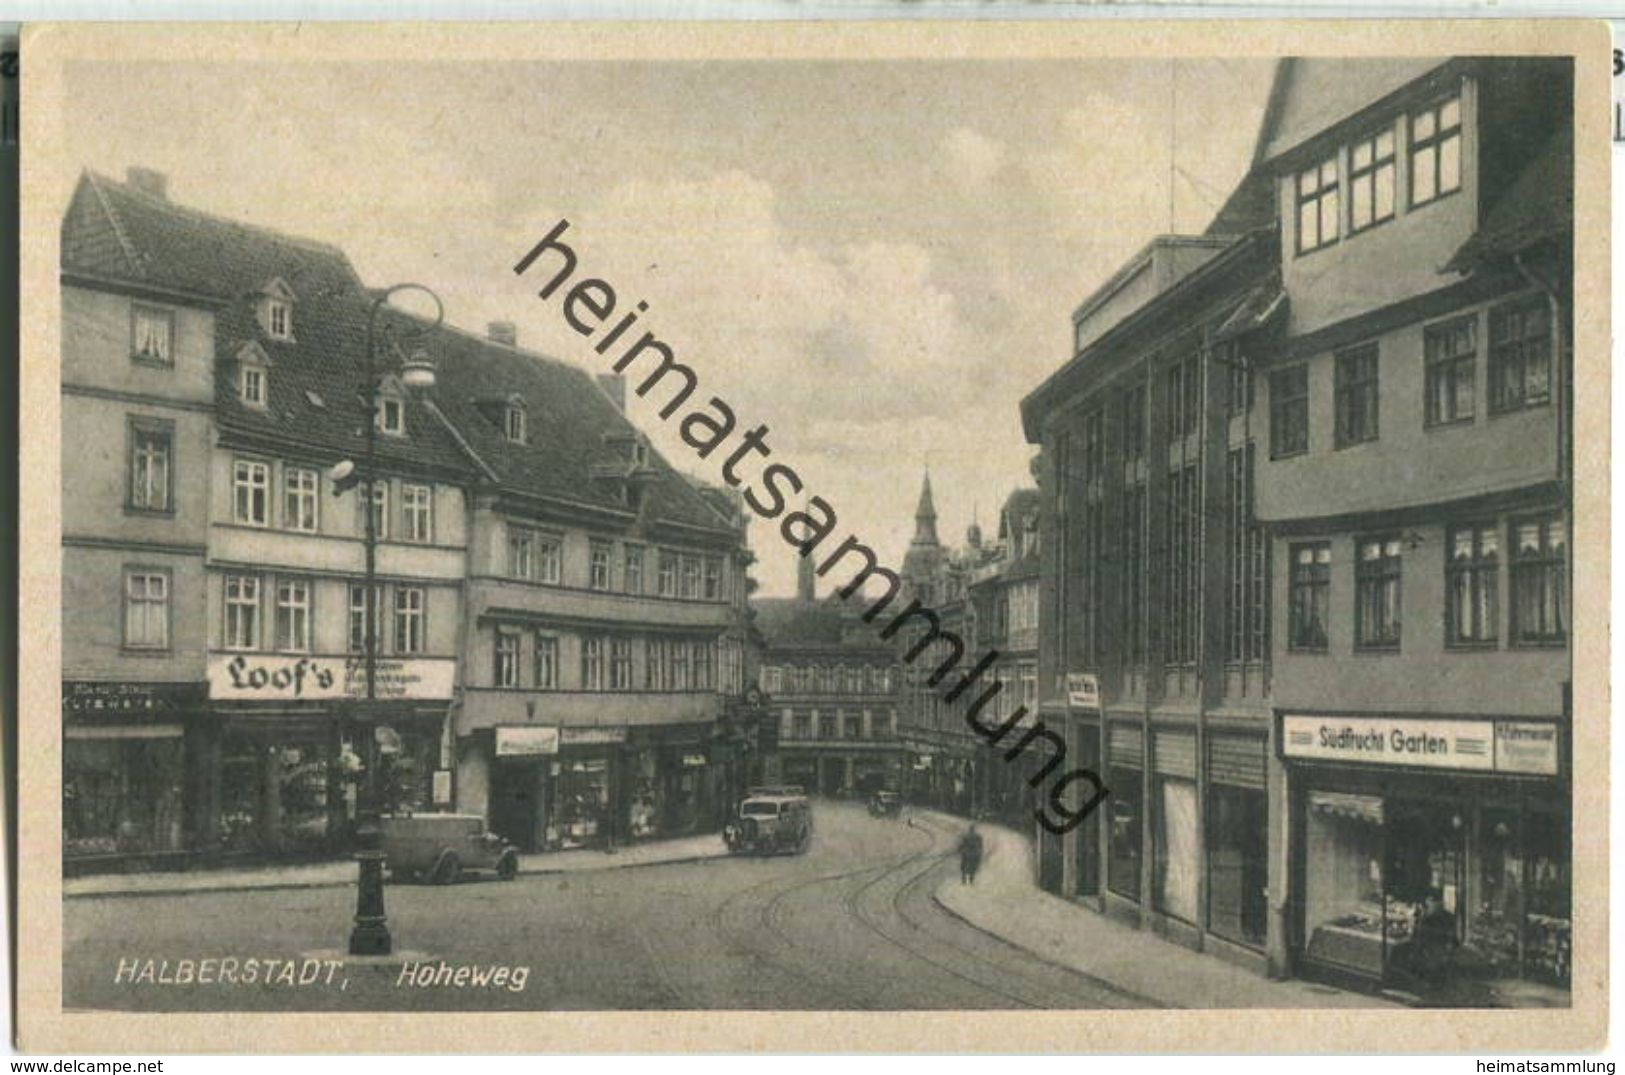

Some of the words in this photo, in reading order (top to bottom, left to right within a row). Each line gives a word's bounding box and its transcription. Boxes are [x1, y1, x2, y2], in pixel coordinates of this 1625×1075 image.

[228, 657, 335, 696] Loof's
[1319, 725, 1384, 751] Südfrucht
[1390, 729, 1448, 755] Garten
